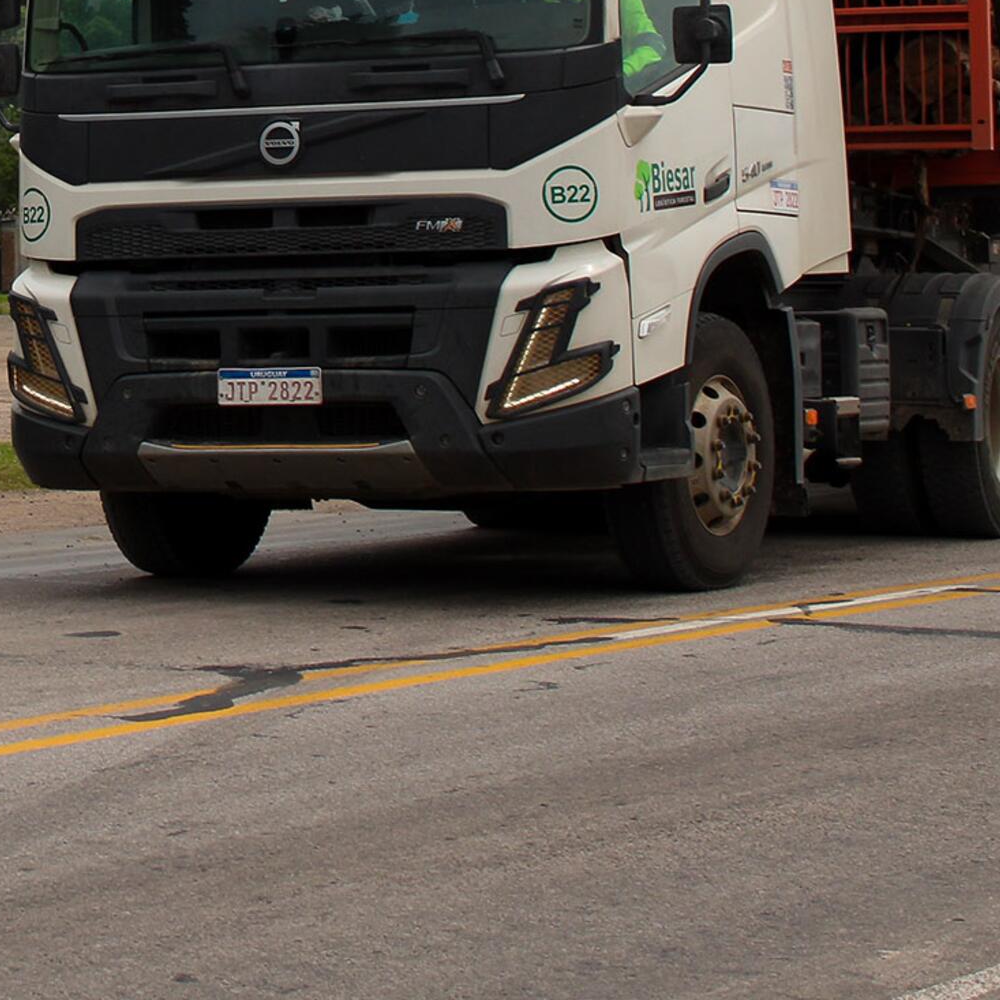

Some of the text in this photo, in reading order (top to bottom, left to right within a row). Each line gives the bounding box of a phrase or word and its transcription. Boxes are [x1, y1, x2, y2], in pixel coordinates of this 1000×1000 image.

[651, 161, 695, 193] Biesar
[551, 185, 591, 204] B22
[23, 206, 45, 224] B22
[225, 381, 314, 401] JTP 2822
